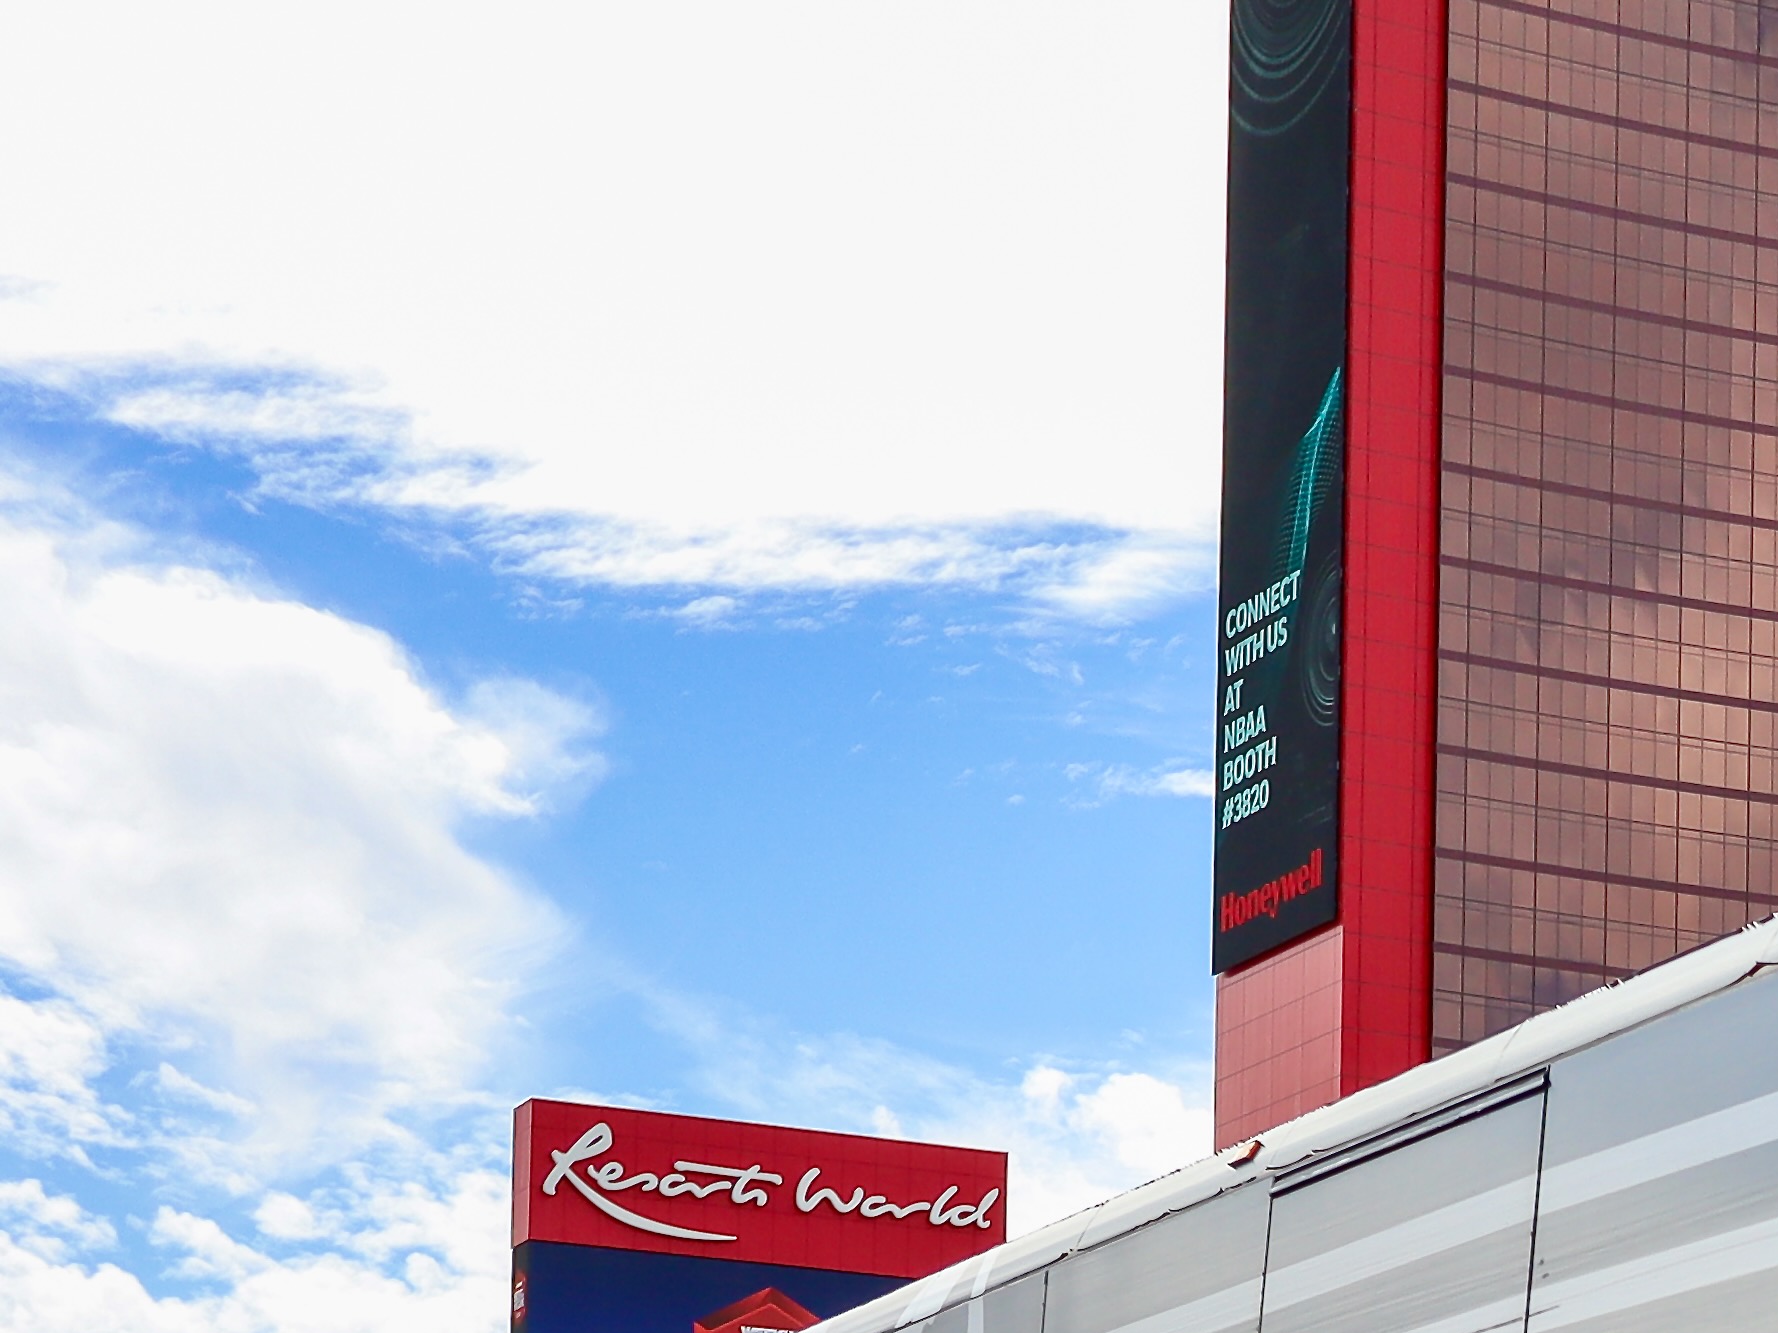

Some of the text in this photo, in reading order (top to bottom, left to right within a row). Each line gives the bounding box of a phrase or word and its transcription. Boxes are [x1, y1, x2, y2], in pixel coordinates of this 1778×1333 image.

[1225, 570, 1300, 639] CONNECT
[1225, 617, 1288, 677] WITH US
[1224, 678, 1244, 716] AT
[1223, 705, 1266, 754] NBAA
[1222, 736, 1277, 792] BOOTH
[1221, 779, 1270, 830] #3820
[1220, 848, 1323, 933] Honeywell
[542, 1122, 1001, 1241] Resorts World
